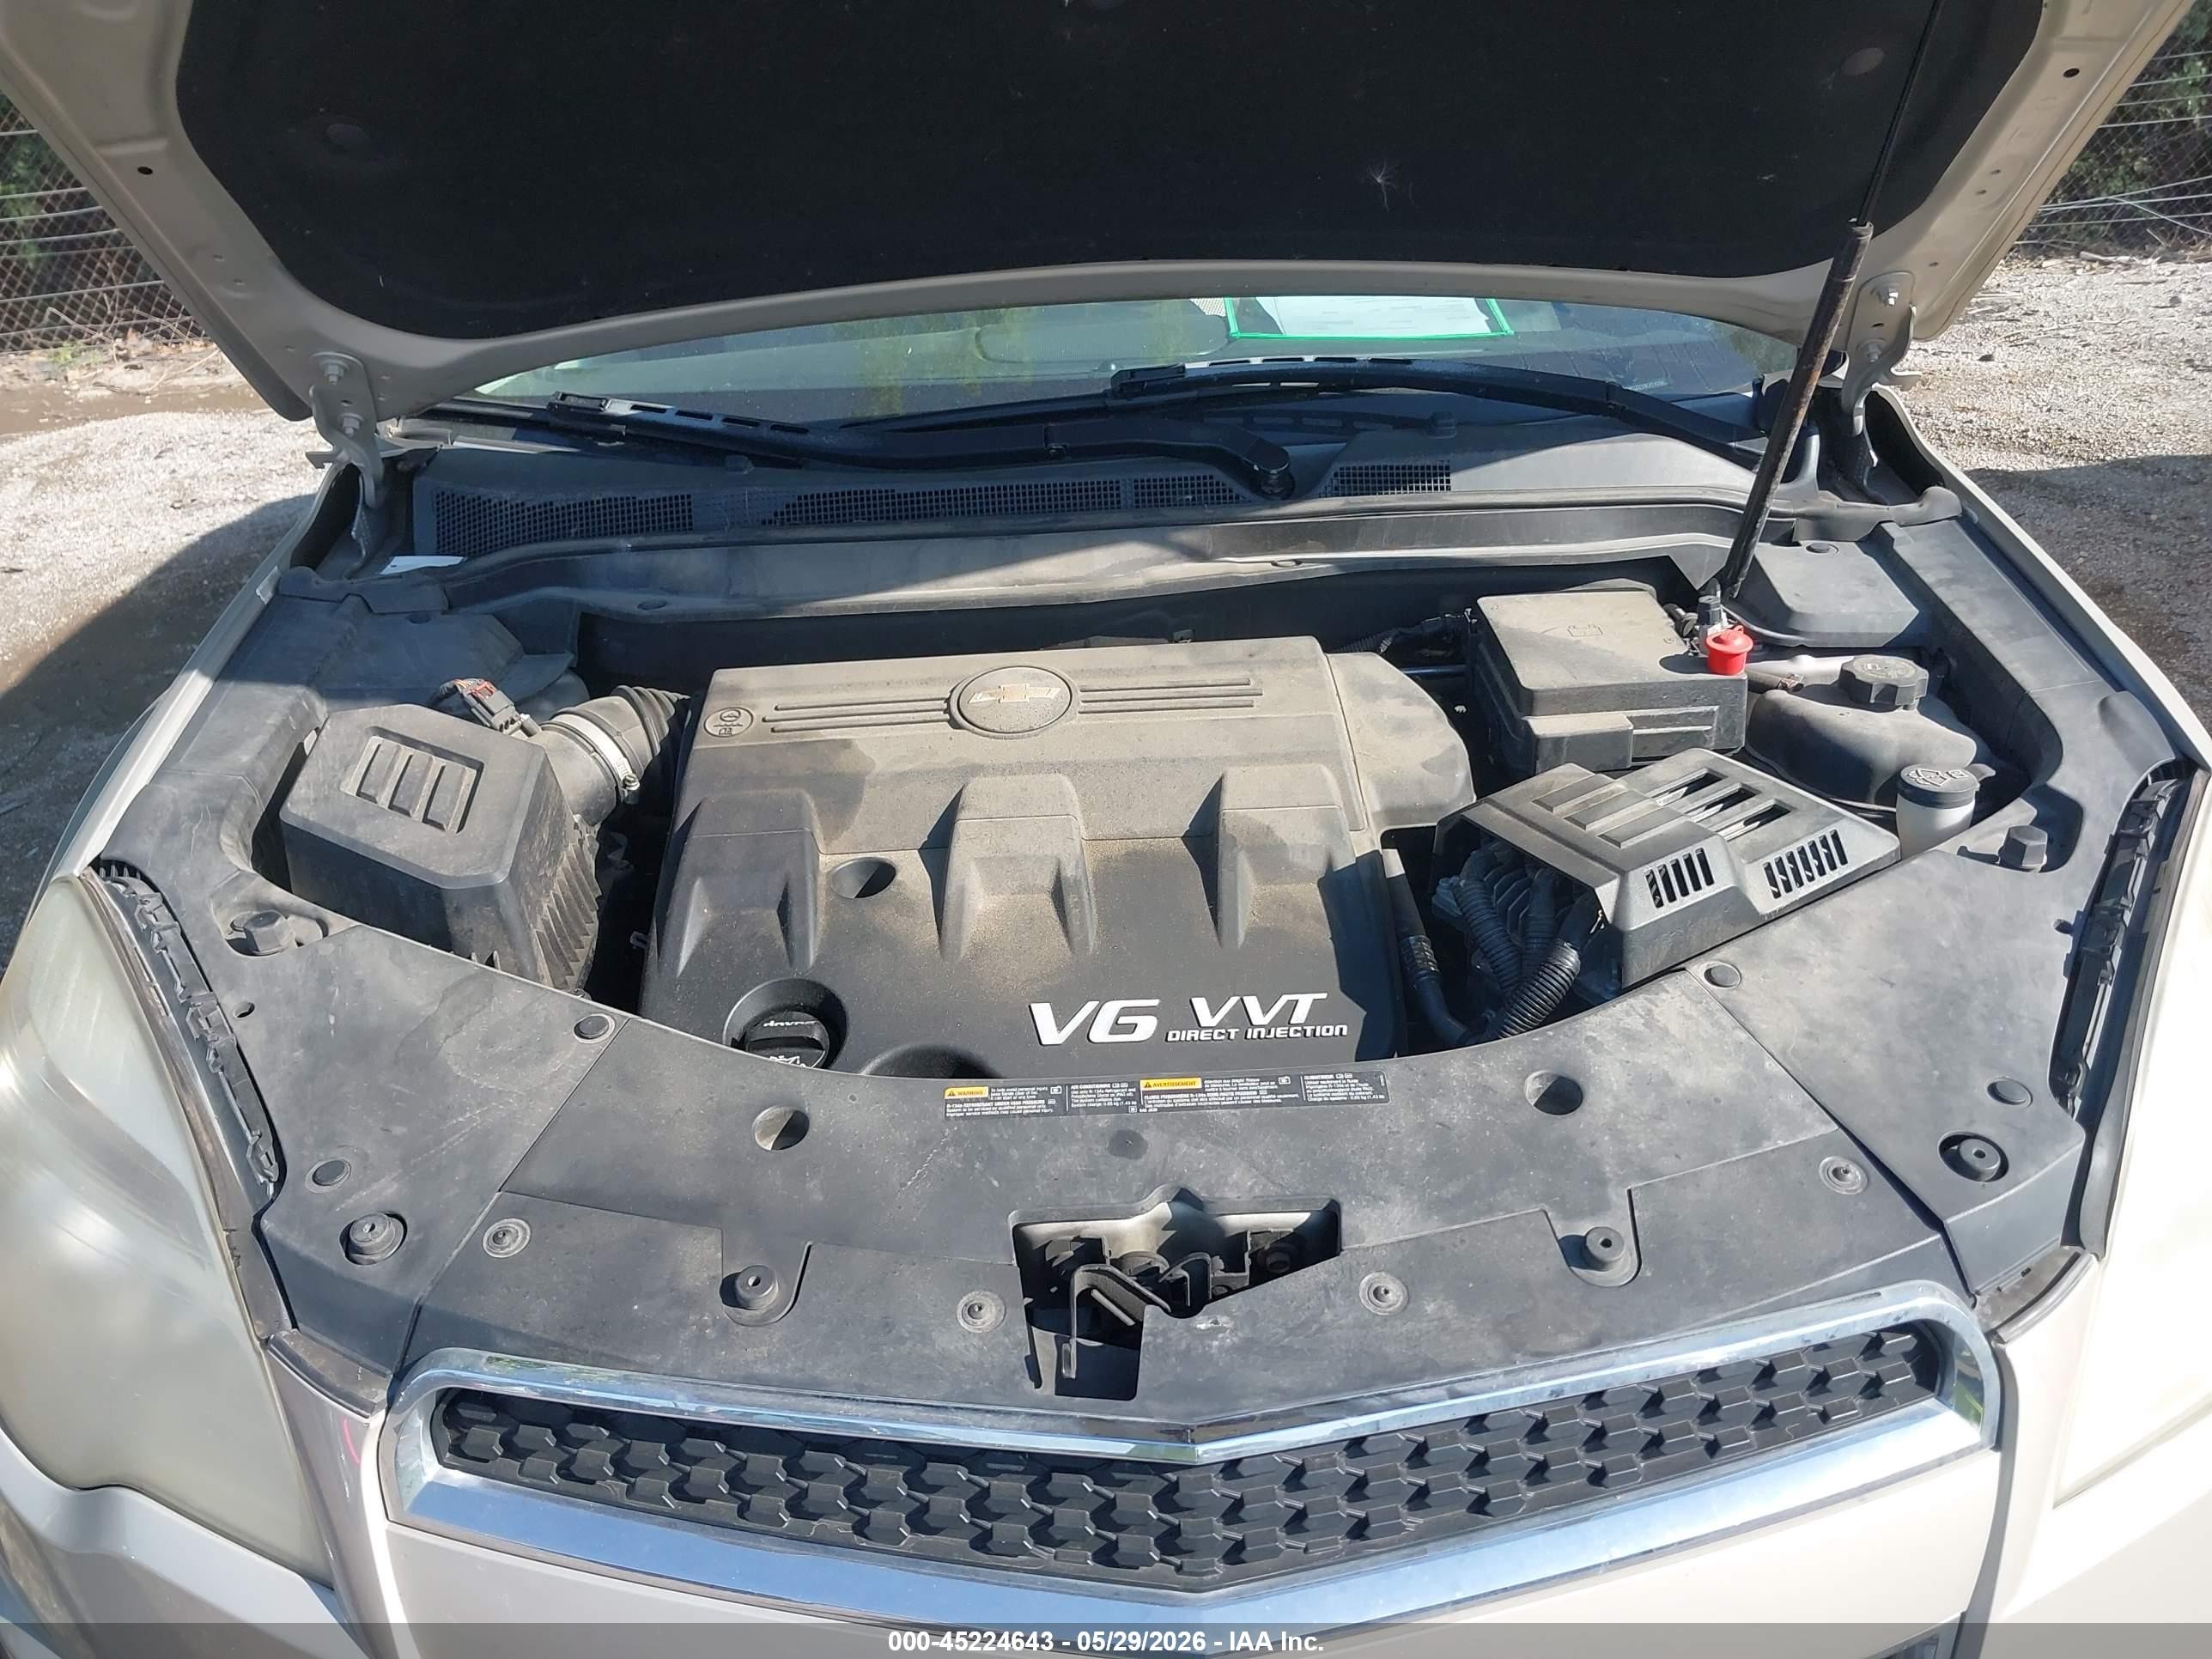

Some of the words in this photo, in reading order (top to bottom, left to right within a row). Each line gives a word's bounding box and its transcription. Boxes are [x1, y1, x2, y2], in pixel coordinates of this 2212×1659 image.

[1030, 999, 1160, 1045] V6
[1190, 993, 1328, 1027] VVT
[1166, 1028, 1240, 1042] DIRECT
[1246, 1024, 1348, 1040] INJECTION
